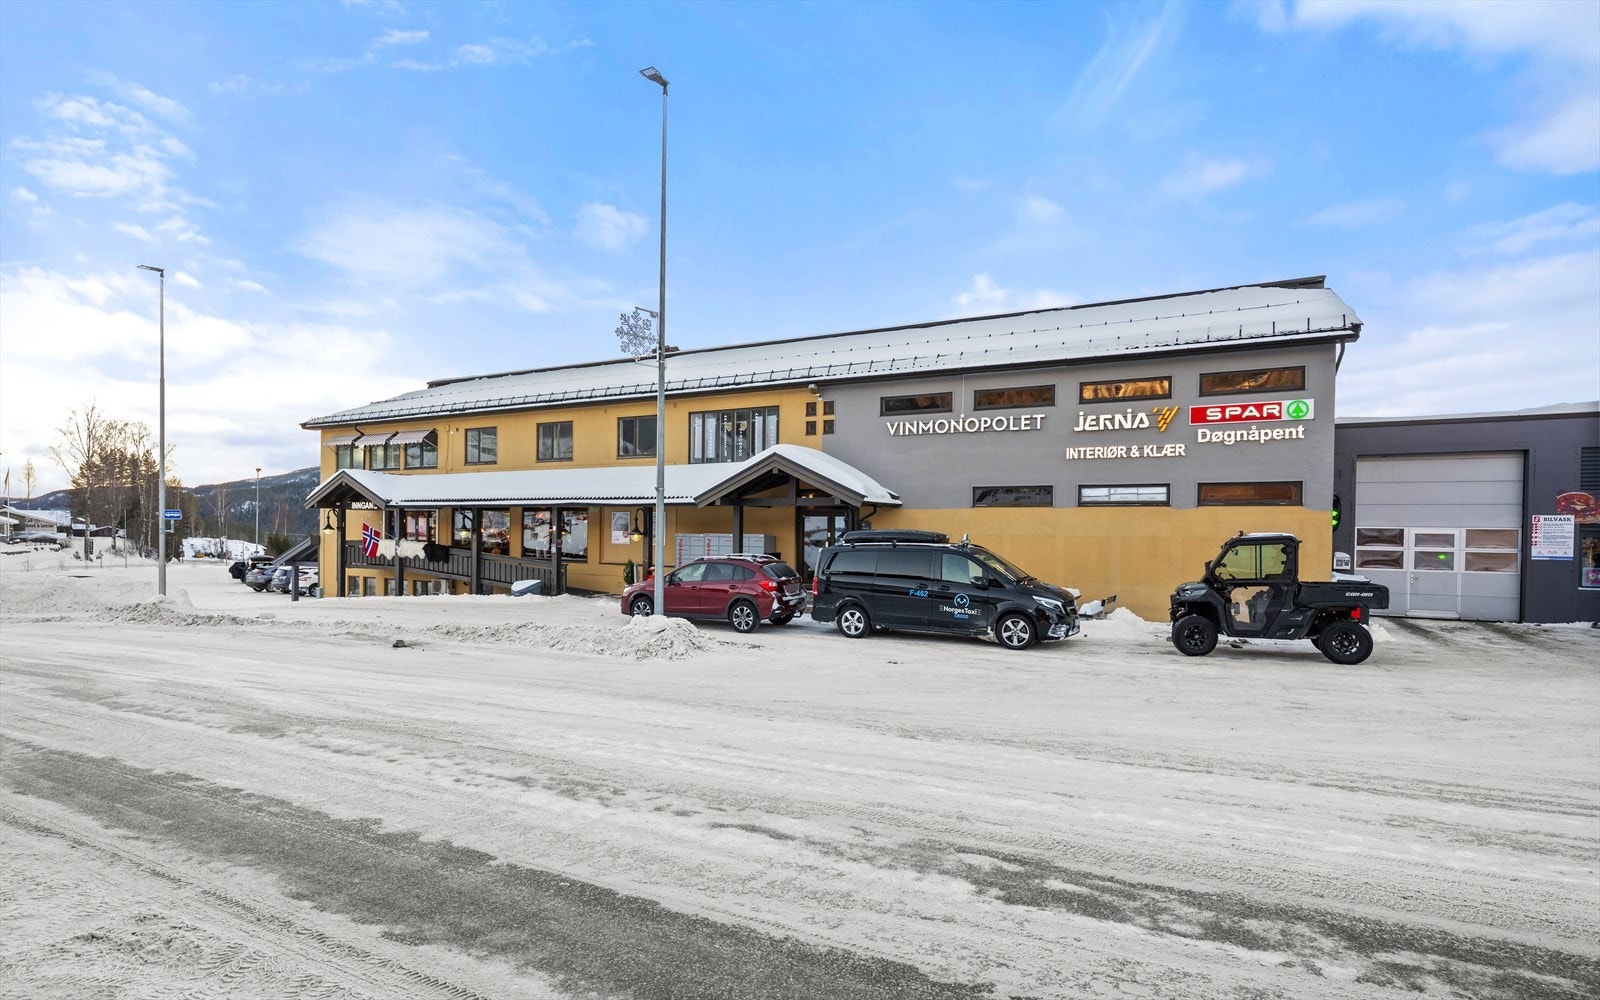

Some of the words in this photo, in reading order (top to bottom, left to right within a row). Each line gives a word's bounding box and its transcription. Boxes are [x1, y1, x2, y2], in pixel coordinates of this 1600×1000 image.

[1206, 404, 1280, 420] SPAR
[886, 414, 1046, 436] VINMONOPOLET
[1197, 424, 1305, 445] Døgnåpent
[1065, 446, 1127, 460] INTERIØR
[1130, 445, 1140, 458] &
[1143, 444, 1186, 458] KLÆR
[909, 589, 929, 598] F-462
